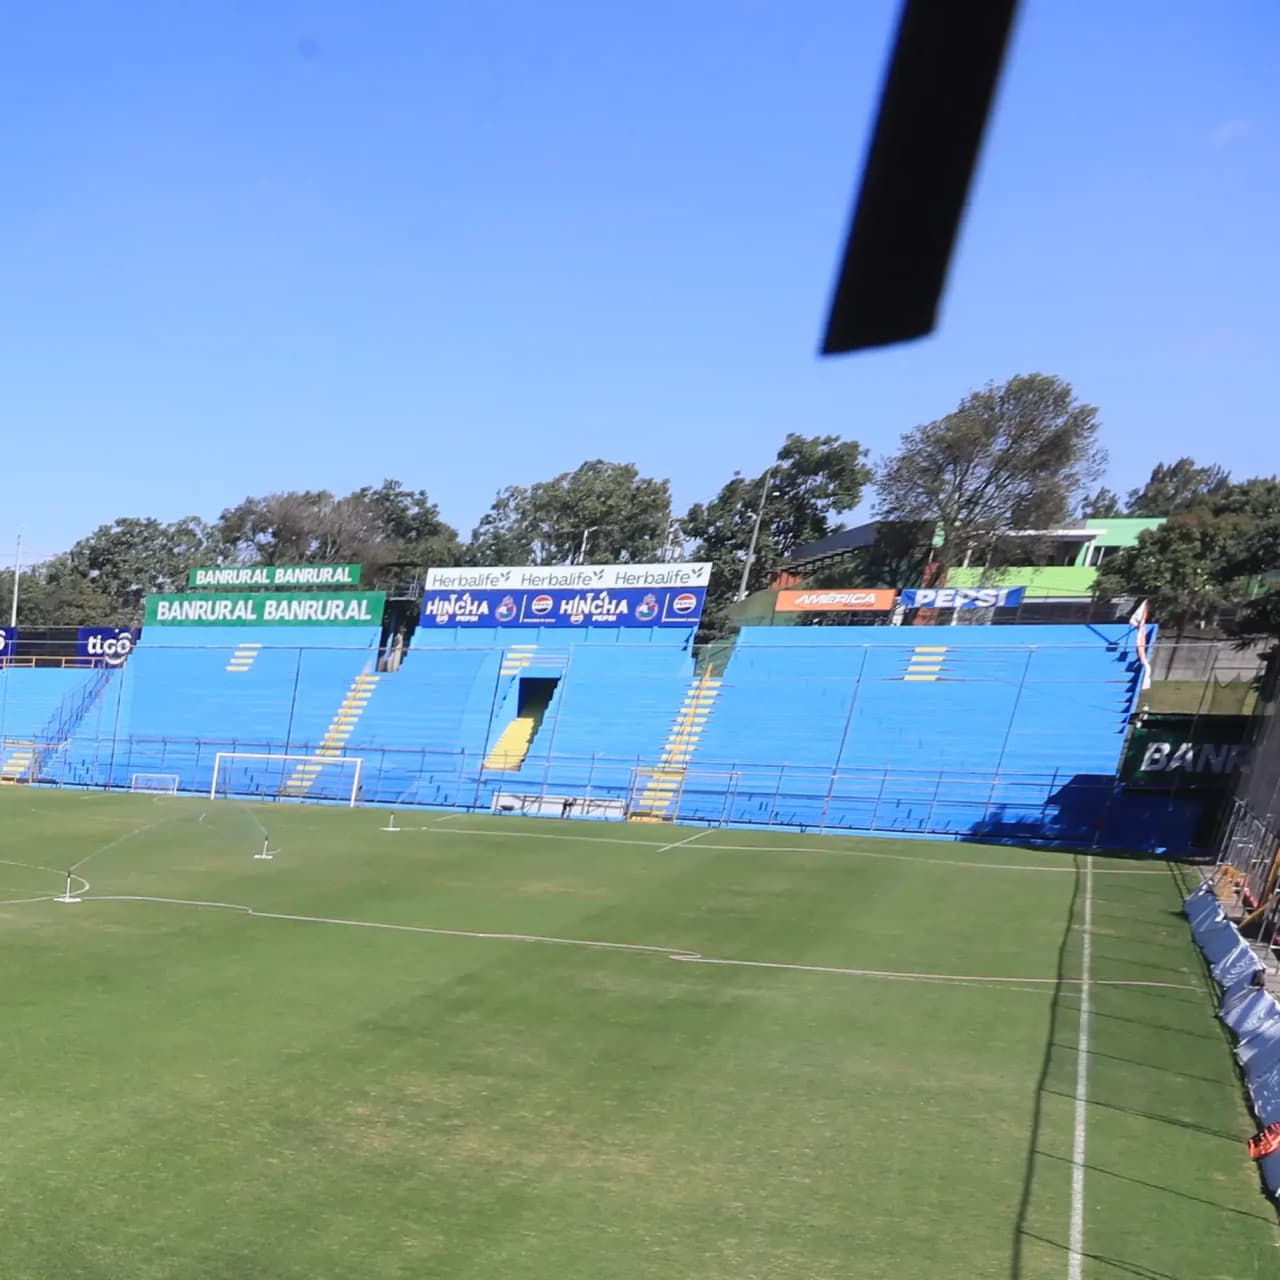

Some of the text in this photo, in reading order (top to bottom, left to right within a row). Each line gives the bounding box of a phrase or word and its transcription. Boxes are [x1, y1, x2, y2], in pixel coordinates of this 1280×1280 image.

[196, 567, 352, 585] BANRURAL BANRURAL
[432, 569, 690, 588] Herbalife Herbalife Herbalife
[425, 593, 490, 615] HINCHA
[559, 591, 628, 615] HINCHA
[914, 588, 1007, 608] PEPSI
[157, 599, 373, 621] BANRURAL BANRURAL
